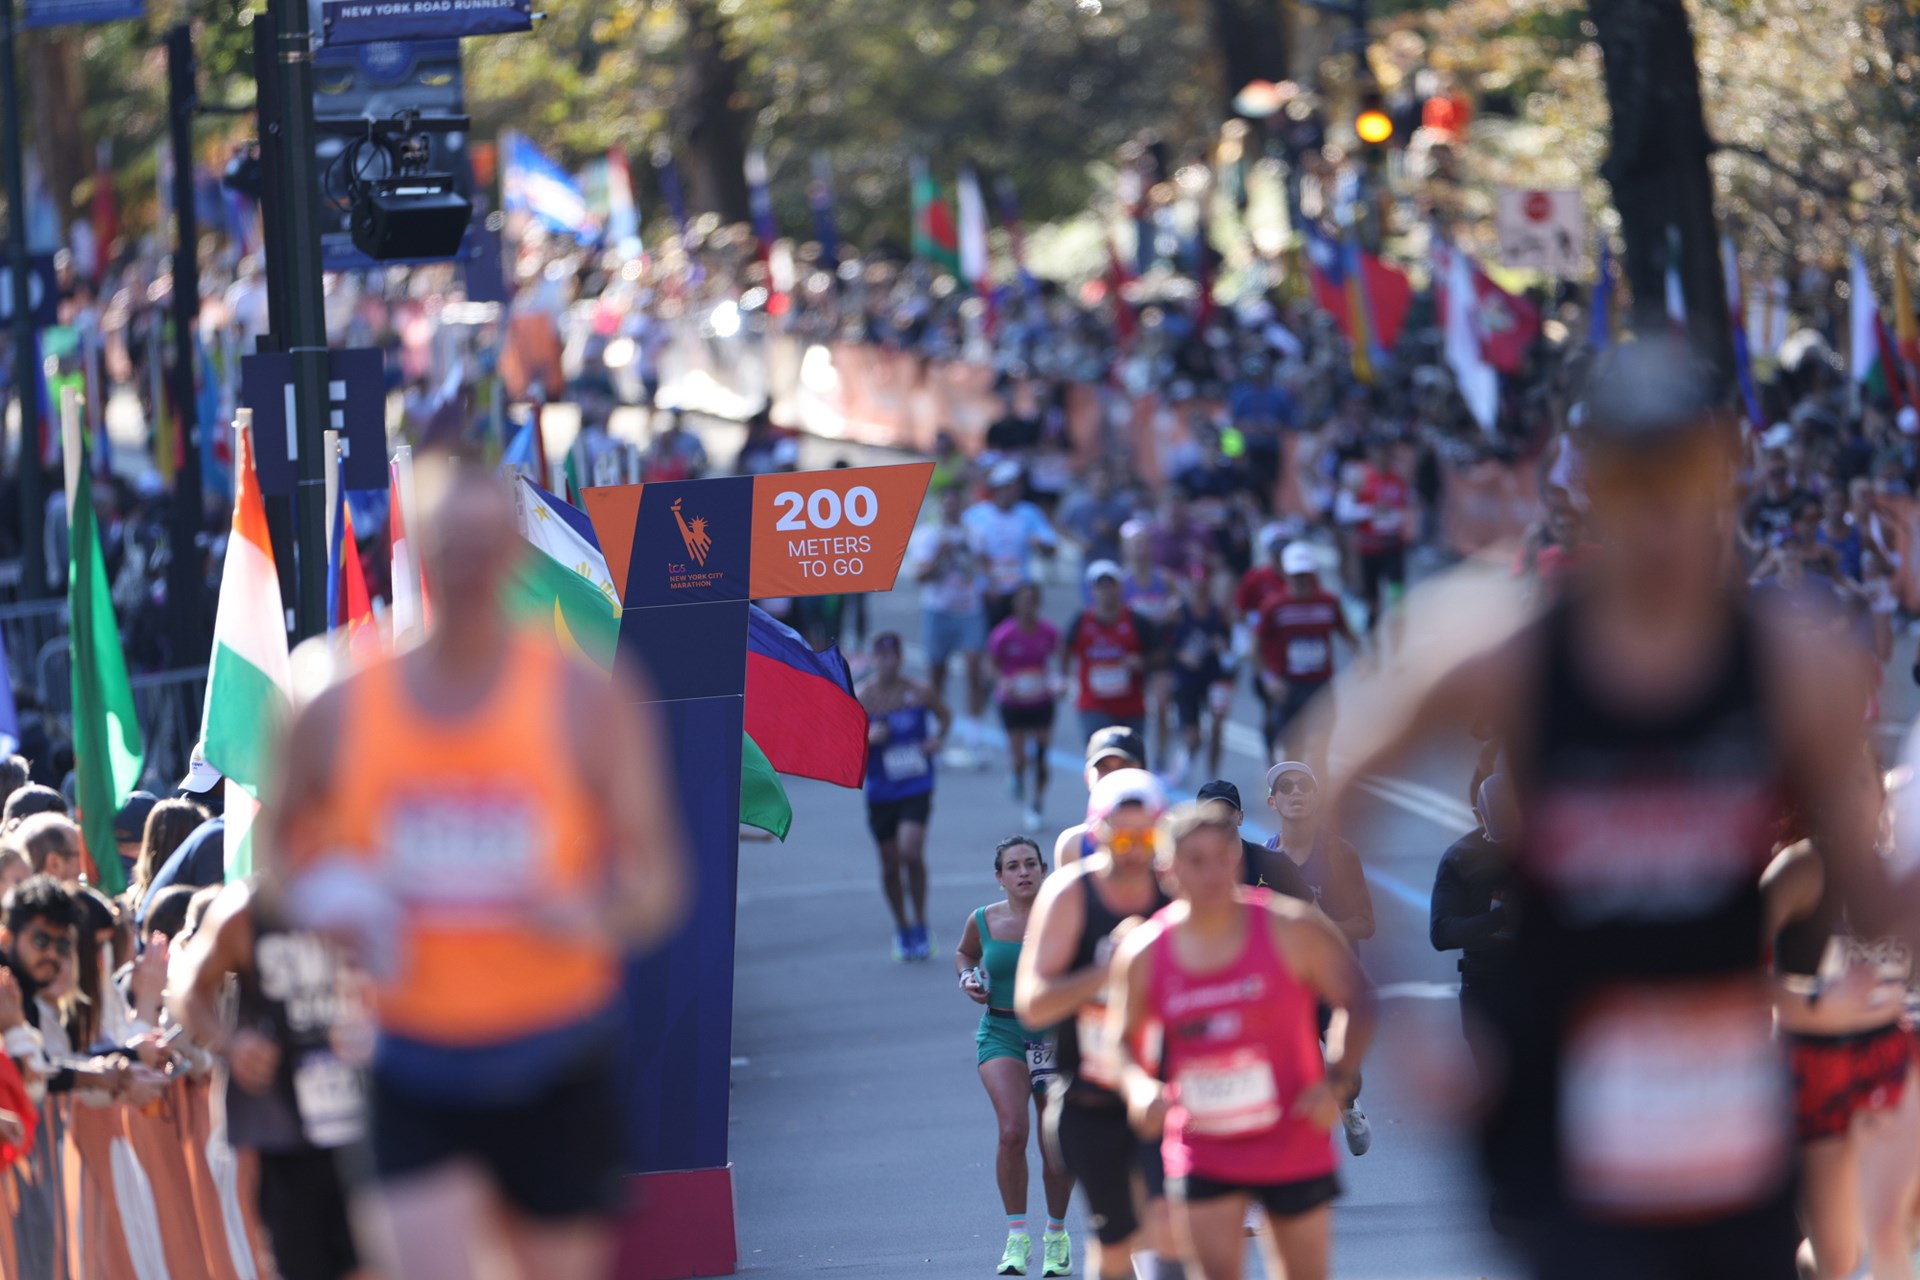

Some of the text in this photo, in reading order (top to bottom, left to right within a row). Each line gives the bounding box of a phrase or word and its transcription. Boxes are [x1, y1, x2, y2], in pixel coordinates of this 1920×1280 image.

[341, 0, 515, 18] NEW YORK ROAD RUNNERS
[774, 485, 878, 531] 200
[788, 535, 871, 557] METERS
[668, 562, 686, 574] tcs
[799, 558, 864, 577] TO GO
[670, 572, 724, 582] NEW YORK CITY
[671, 580, 711, 589] MARATHON
